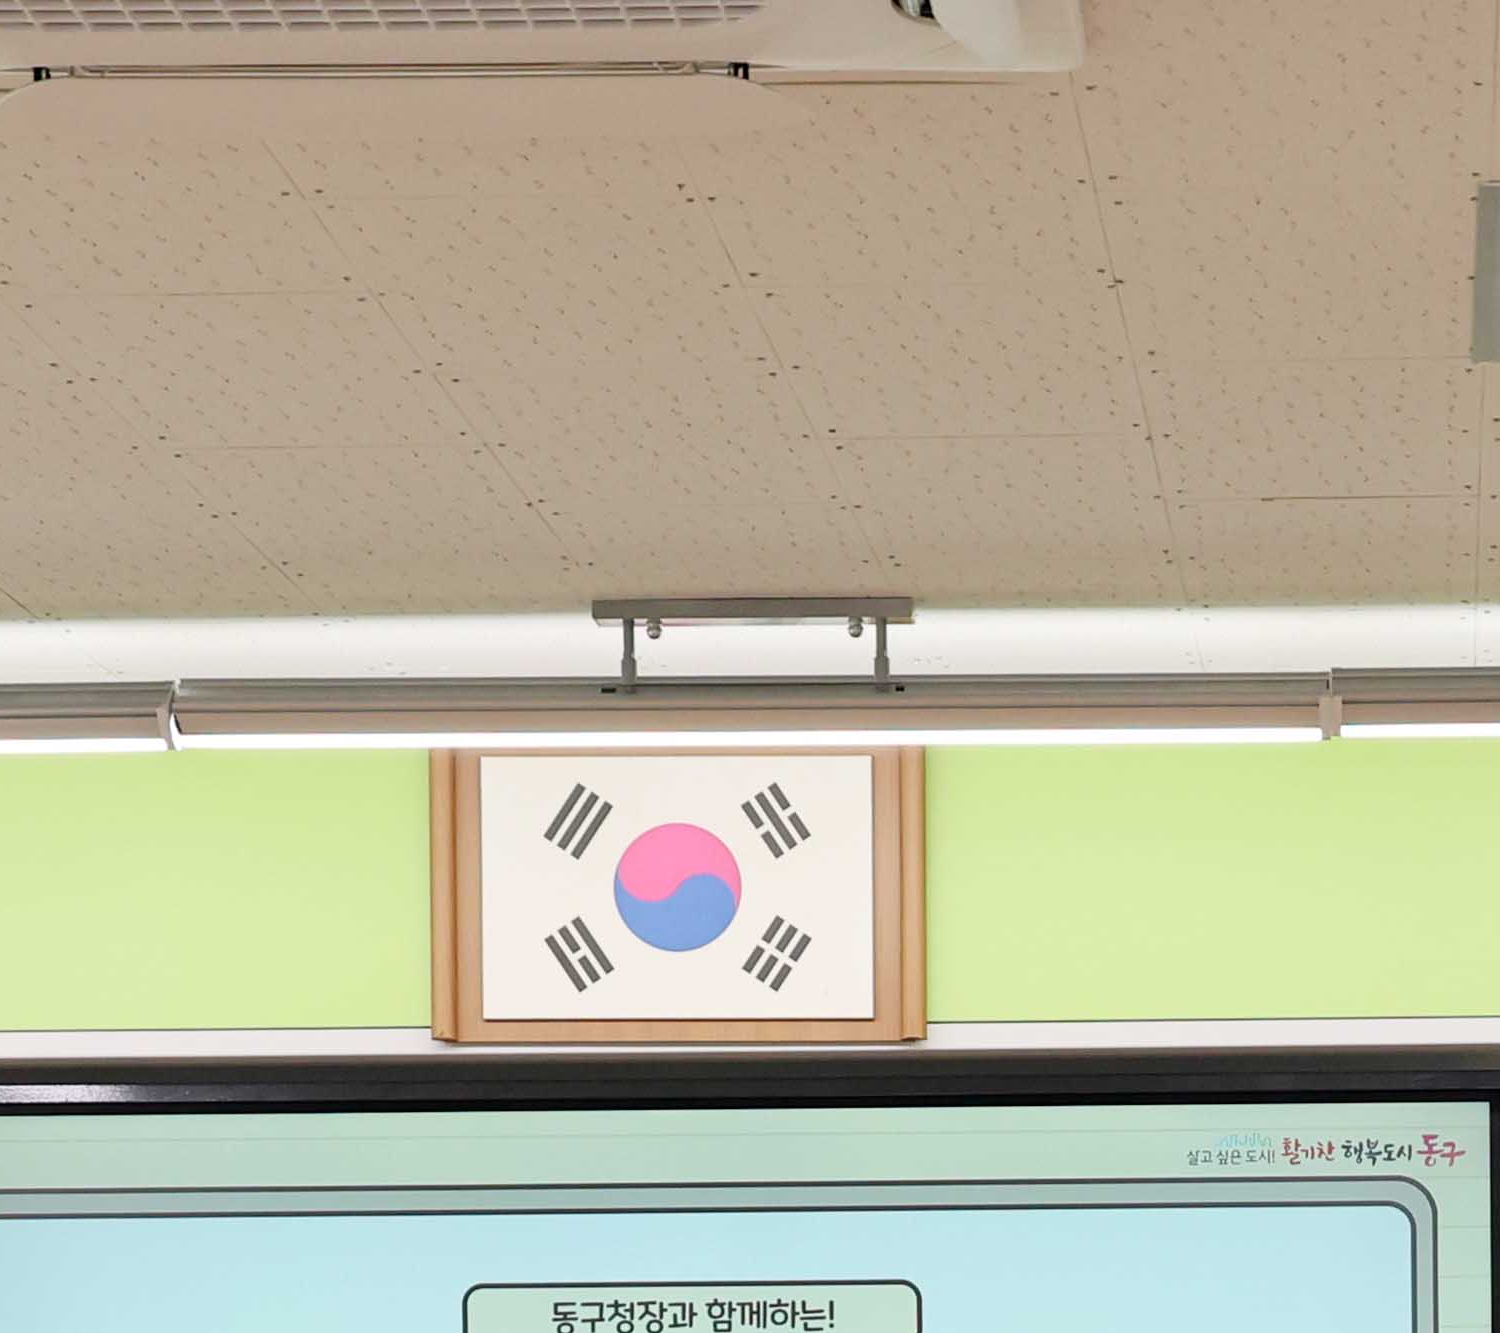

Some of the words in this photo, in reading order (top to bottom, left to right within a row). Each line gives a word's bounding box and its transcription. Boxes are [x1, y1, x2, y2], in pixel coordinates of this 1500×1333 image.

[1187, 1149, 1213, 1166] 살고
[1217, 1149, 1241, 1165] 싶은
[1244, 1148, 1275, 1165] 도시!
[1280, 1137, 1336, 1165] 활기찬
[1341, 1138, 1413, 1167] 행복도시
[1416, 1133, 1466, 1167] 동구
[705, 1297, 836, 1333] 함께하는!
